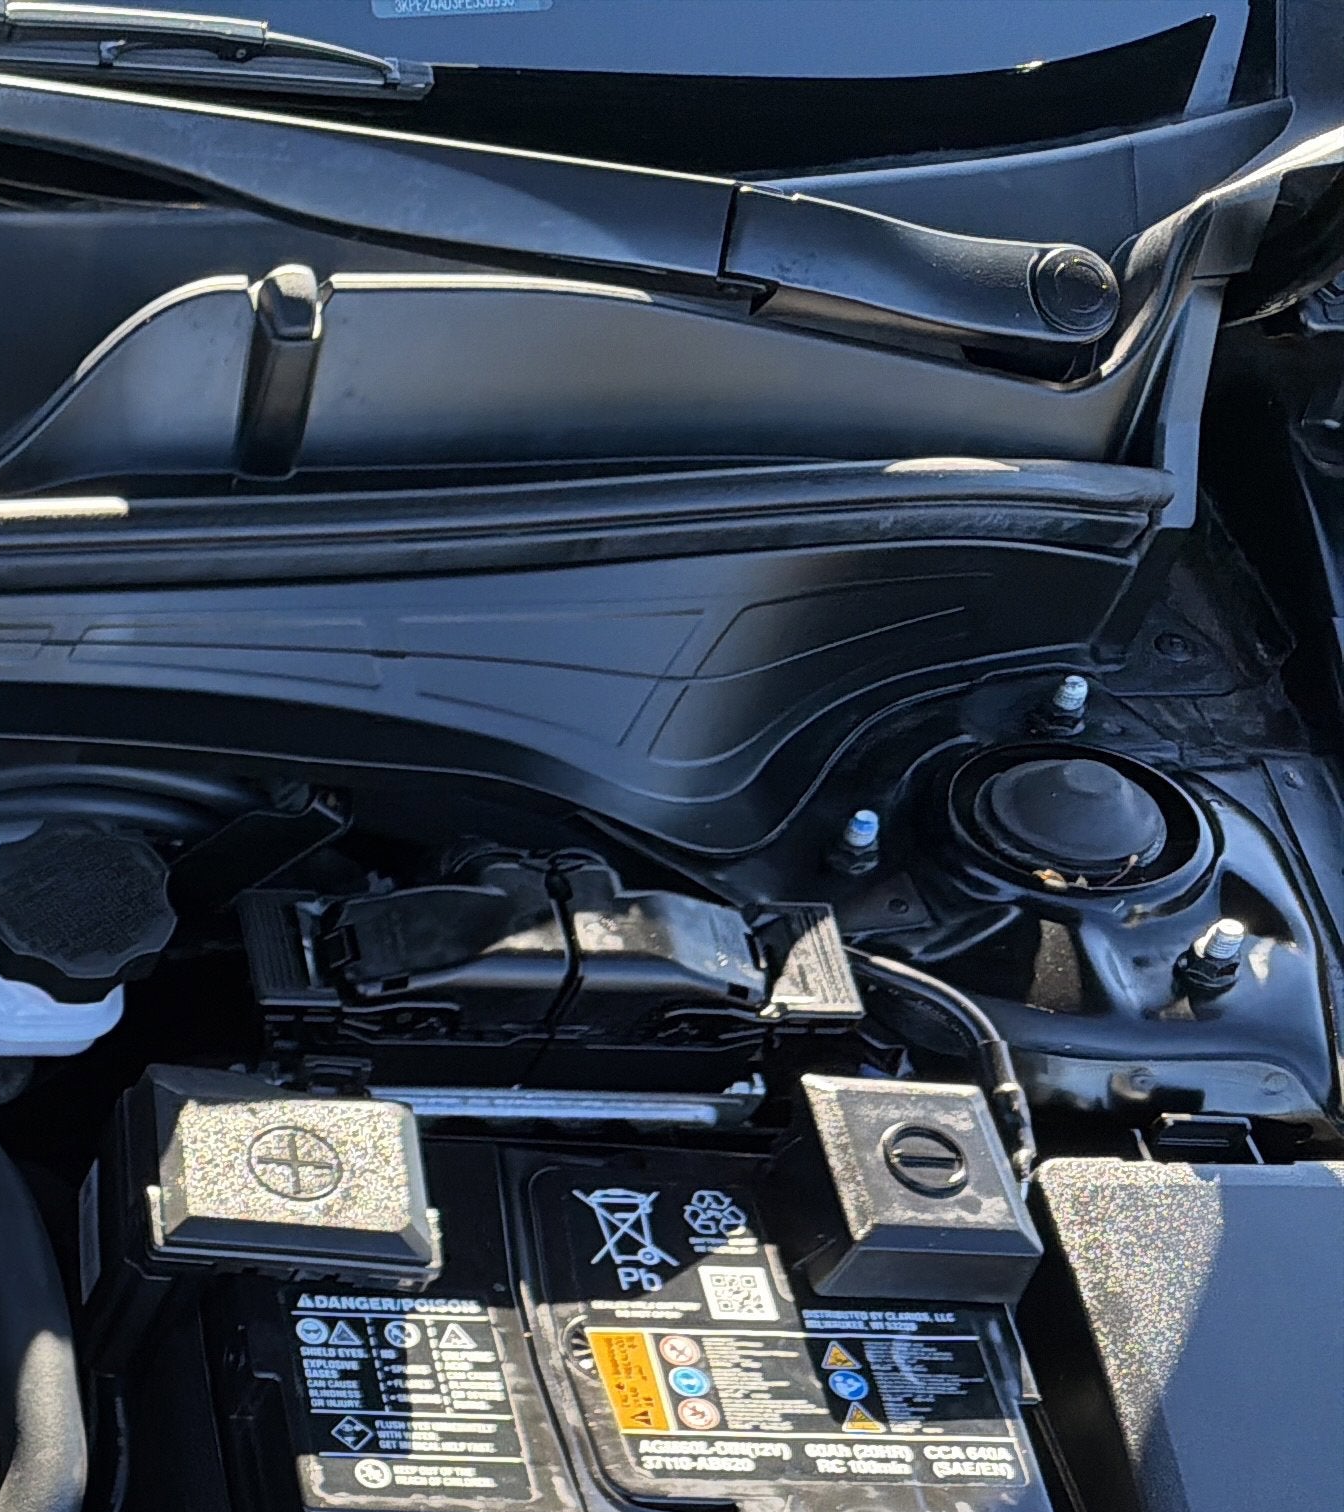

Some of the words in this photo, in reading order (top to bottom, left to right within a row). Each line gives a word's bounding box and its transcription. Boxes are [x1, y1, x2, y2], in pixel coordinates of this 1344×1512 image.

[616, 1268, 663, 1292] Pb
[313, 1295, 481, 1314] DANGER/POISON
[300, 1346, 336, 1357] SHIELD
[302, 1359, 360, 1370] EXPLOSIVE
[375, 1420, 405, 1429] FLUSH
[923, 1445, 966, 1460] CCA
